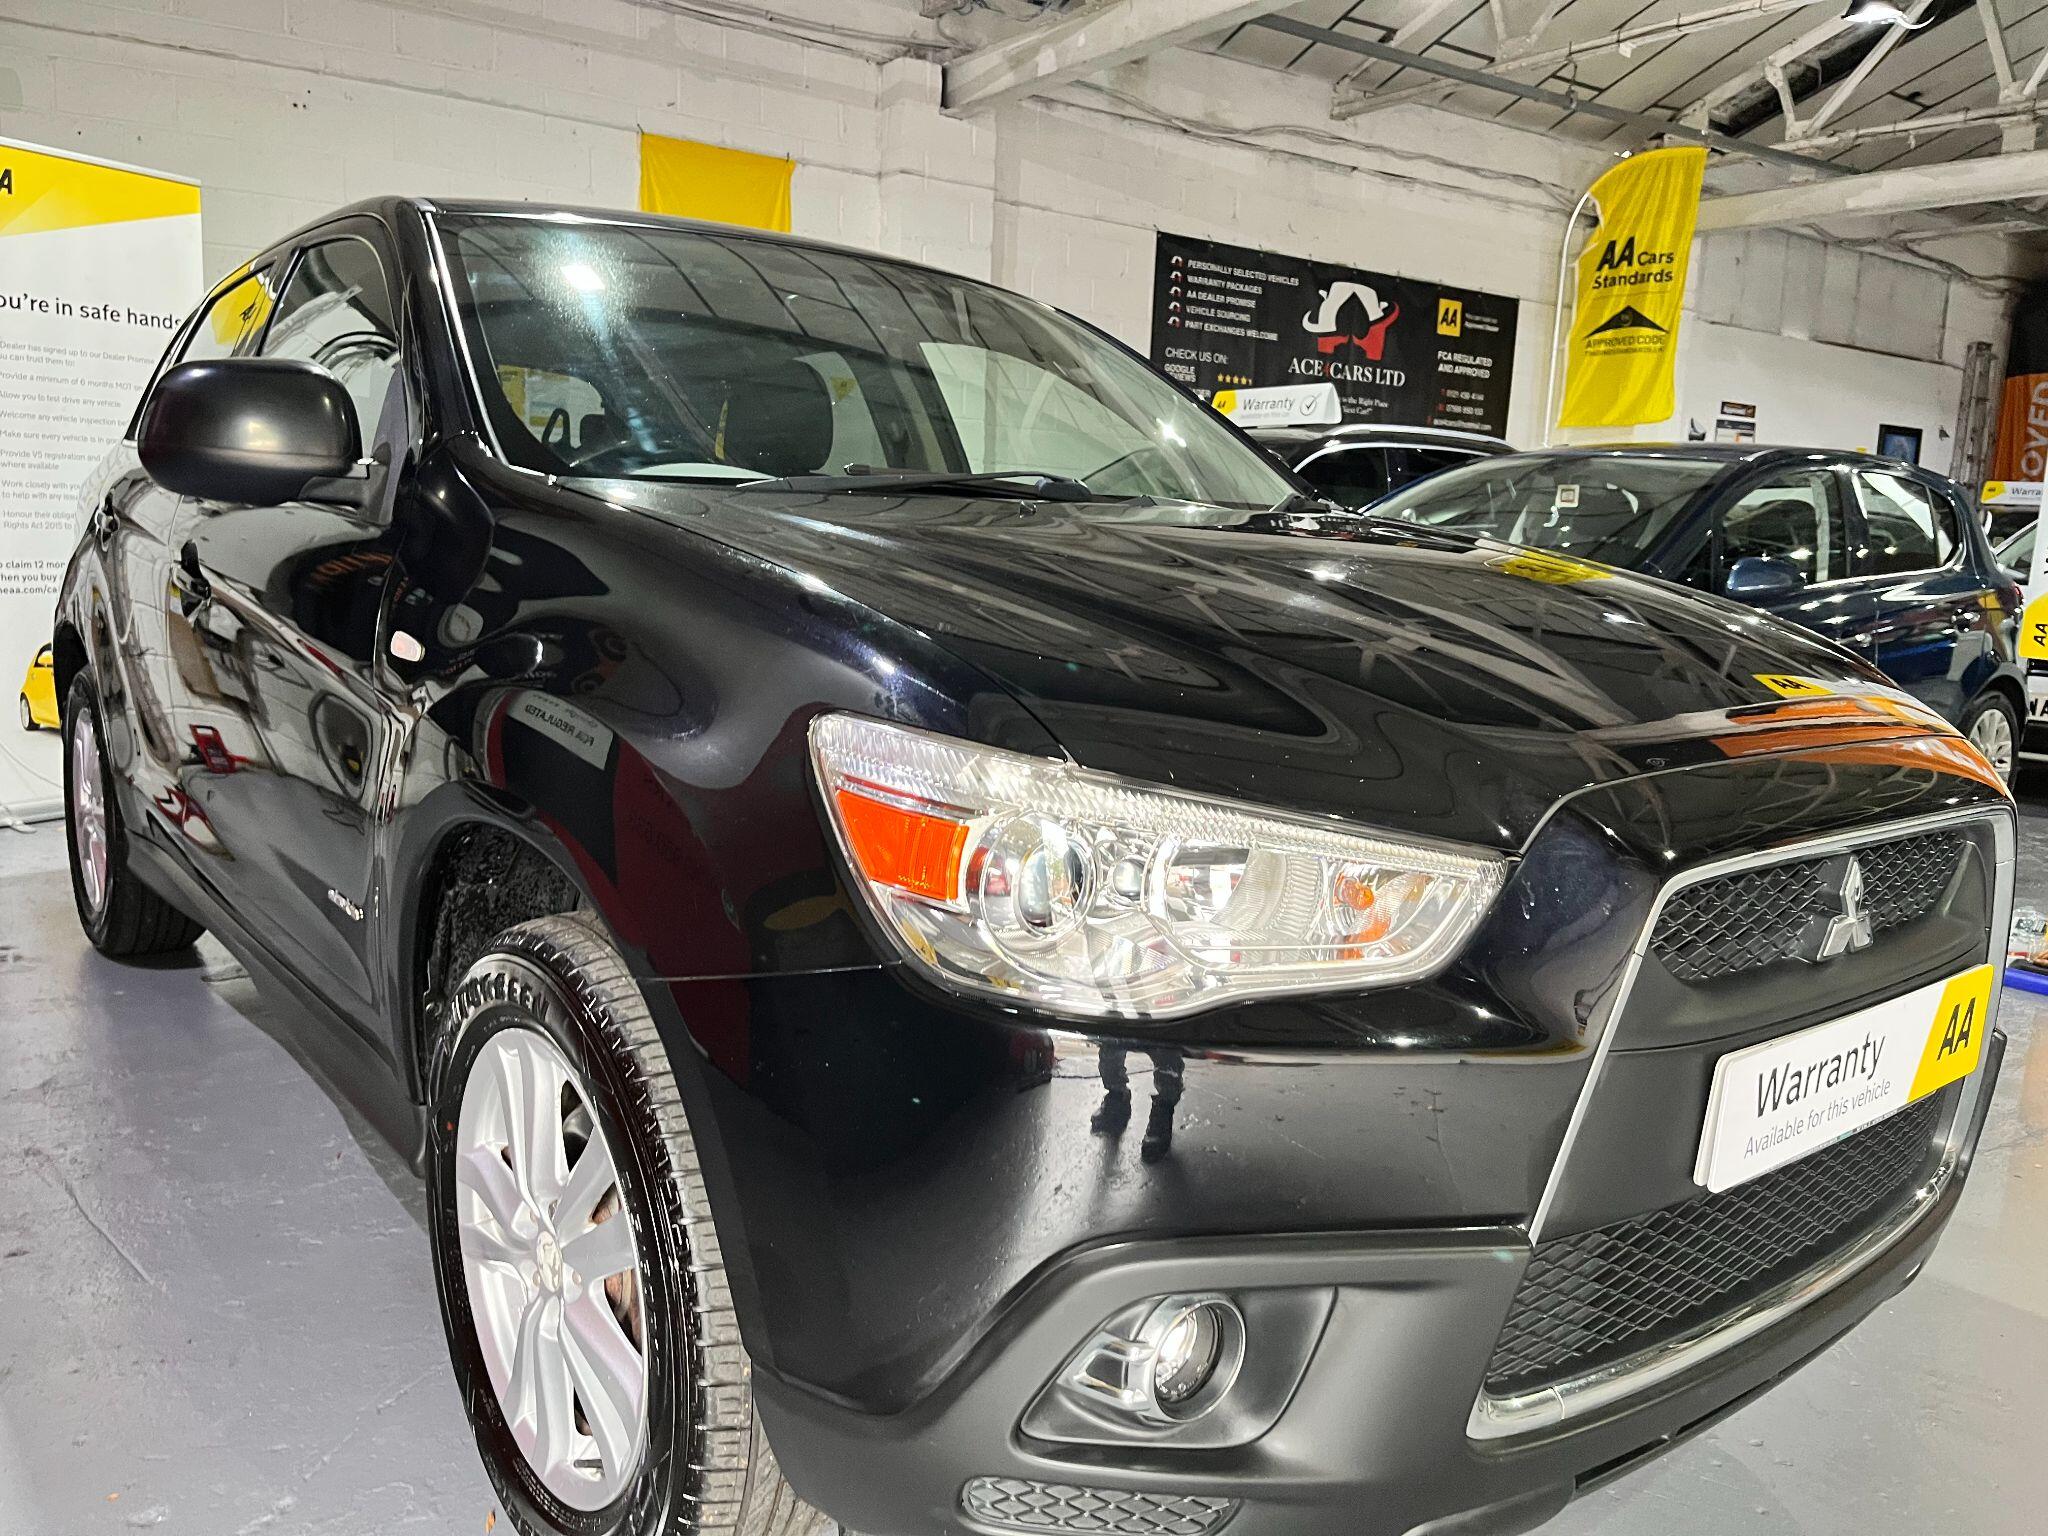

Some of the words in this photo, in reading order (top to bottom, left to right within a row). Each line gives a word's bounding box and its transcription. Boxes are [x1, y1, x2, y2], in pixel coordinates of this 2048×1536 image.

[1596, 236, 1636, 272] AA
[1637, 250, 1674, 266] Cars
[1187, 259, 1232, 275] PERSONALLY
[1232, 268, 1267, 281] SELECTED
[1267, 274, 1300, 286] VEHICLES
[1592, 269, 1673, 290] Standards
[1187, 275, 1226, 289] WARRANTY
[1226, 281, 1263, 295] PACKAGES
[1186, 290, 1197, 299] AA
[1198, 292, 1225, 303] DEALER
[1226, 296, 1256, 309] PROMISE
[56, 297, 73, 316] in
[80, 304, 120, 322] safe
[1186, 305, 1215, 317] VEHICLE
[1216, 310, 1251, 322] SOURCING
[1440, 307, 1458, 327] AA
[1185, 320, 1203, 331] PART
[1203, 323, 1246, 337] EXCHANGES
[1246, 329, 1279, 341] WELCOME
[1585, 335, 1636, 350] APPROVED
[43, 346, 67, 356] signed
[103, 353, 126, 361] Dealer
[1165, 347, 1198, 361] CHECK
[1199, 351, 1213, 362] US
[1437, 351, 1452, 361] FCA
[1453, 353, 1493, 367] REGULATED
[46, 357, 64, 366] them
[1164, 363, 1196, 375] GOOGLE
[1288, 357, 1324, 377] ACE
[1330, 361, 1373, 382] CARS
[1375, 369, 1406, 387] LTD
[1438, 364, 1453, 373] AND
[1454, 366, 1491, 379] APPROVED
[87, 381, 114, 389] months
[82, 399, 95, 408] any
[97, 400, 121, 408] vehicle
[1243, 398, 1294, 412] Warranty
[0, 410, 36, 419] Welcome
[52, 415, 78, 423] vehicle
[80, 418, 116, 426] inspection
[42, 434, 60, 442] every
[2020, 380, 2048, 482] OVED
[0, 449, 30, 457] Provide
[45, 452, 85, 461] registration
[1, 460, 26, 468] where
[28, 462, 59, 470] available
[1, 480, 23, 488] Work
[25, 480, 50, 490] closely
[13, 491, 30, 499] help
[49, 494, 61, 502] any
[3, 510, 32, 518] Honour
[3, 521, 29, 530] Rights
[31, 521, 43, 529] Act
[44, 521, 62, 530] 2015
[5, 560, 32, 569] claim
[35, 560, 44, 569] 12
[21, 574, 39, 583] you
[40, 573, 57, 583] buy
[1937, 997, 1976, 1061] AA
[1757, 1031, 1886, 1118] Warranty
[1744, 1117, 1804, 1159] Available
[1807, 1108, 1825, 1134] for
[1827, 1098, 1848, 1122] this
[1851, 1079, 1891, 1110] vehicle
